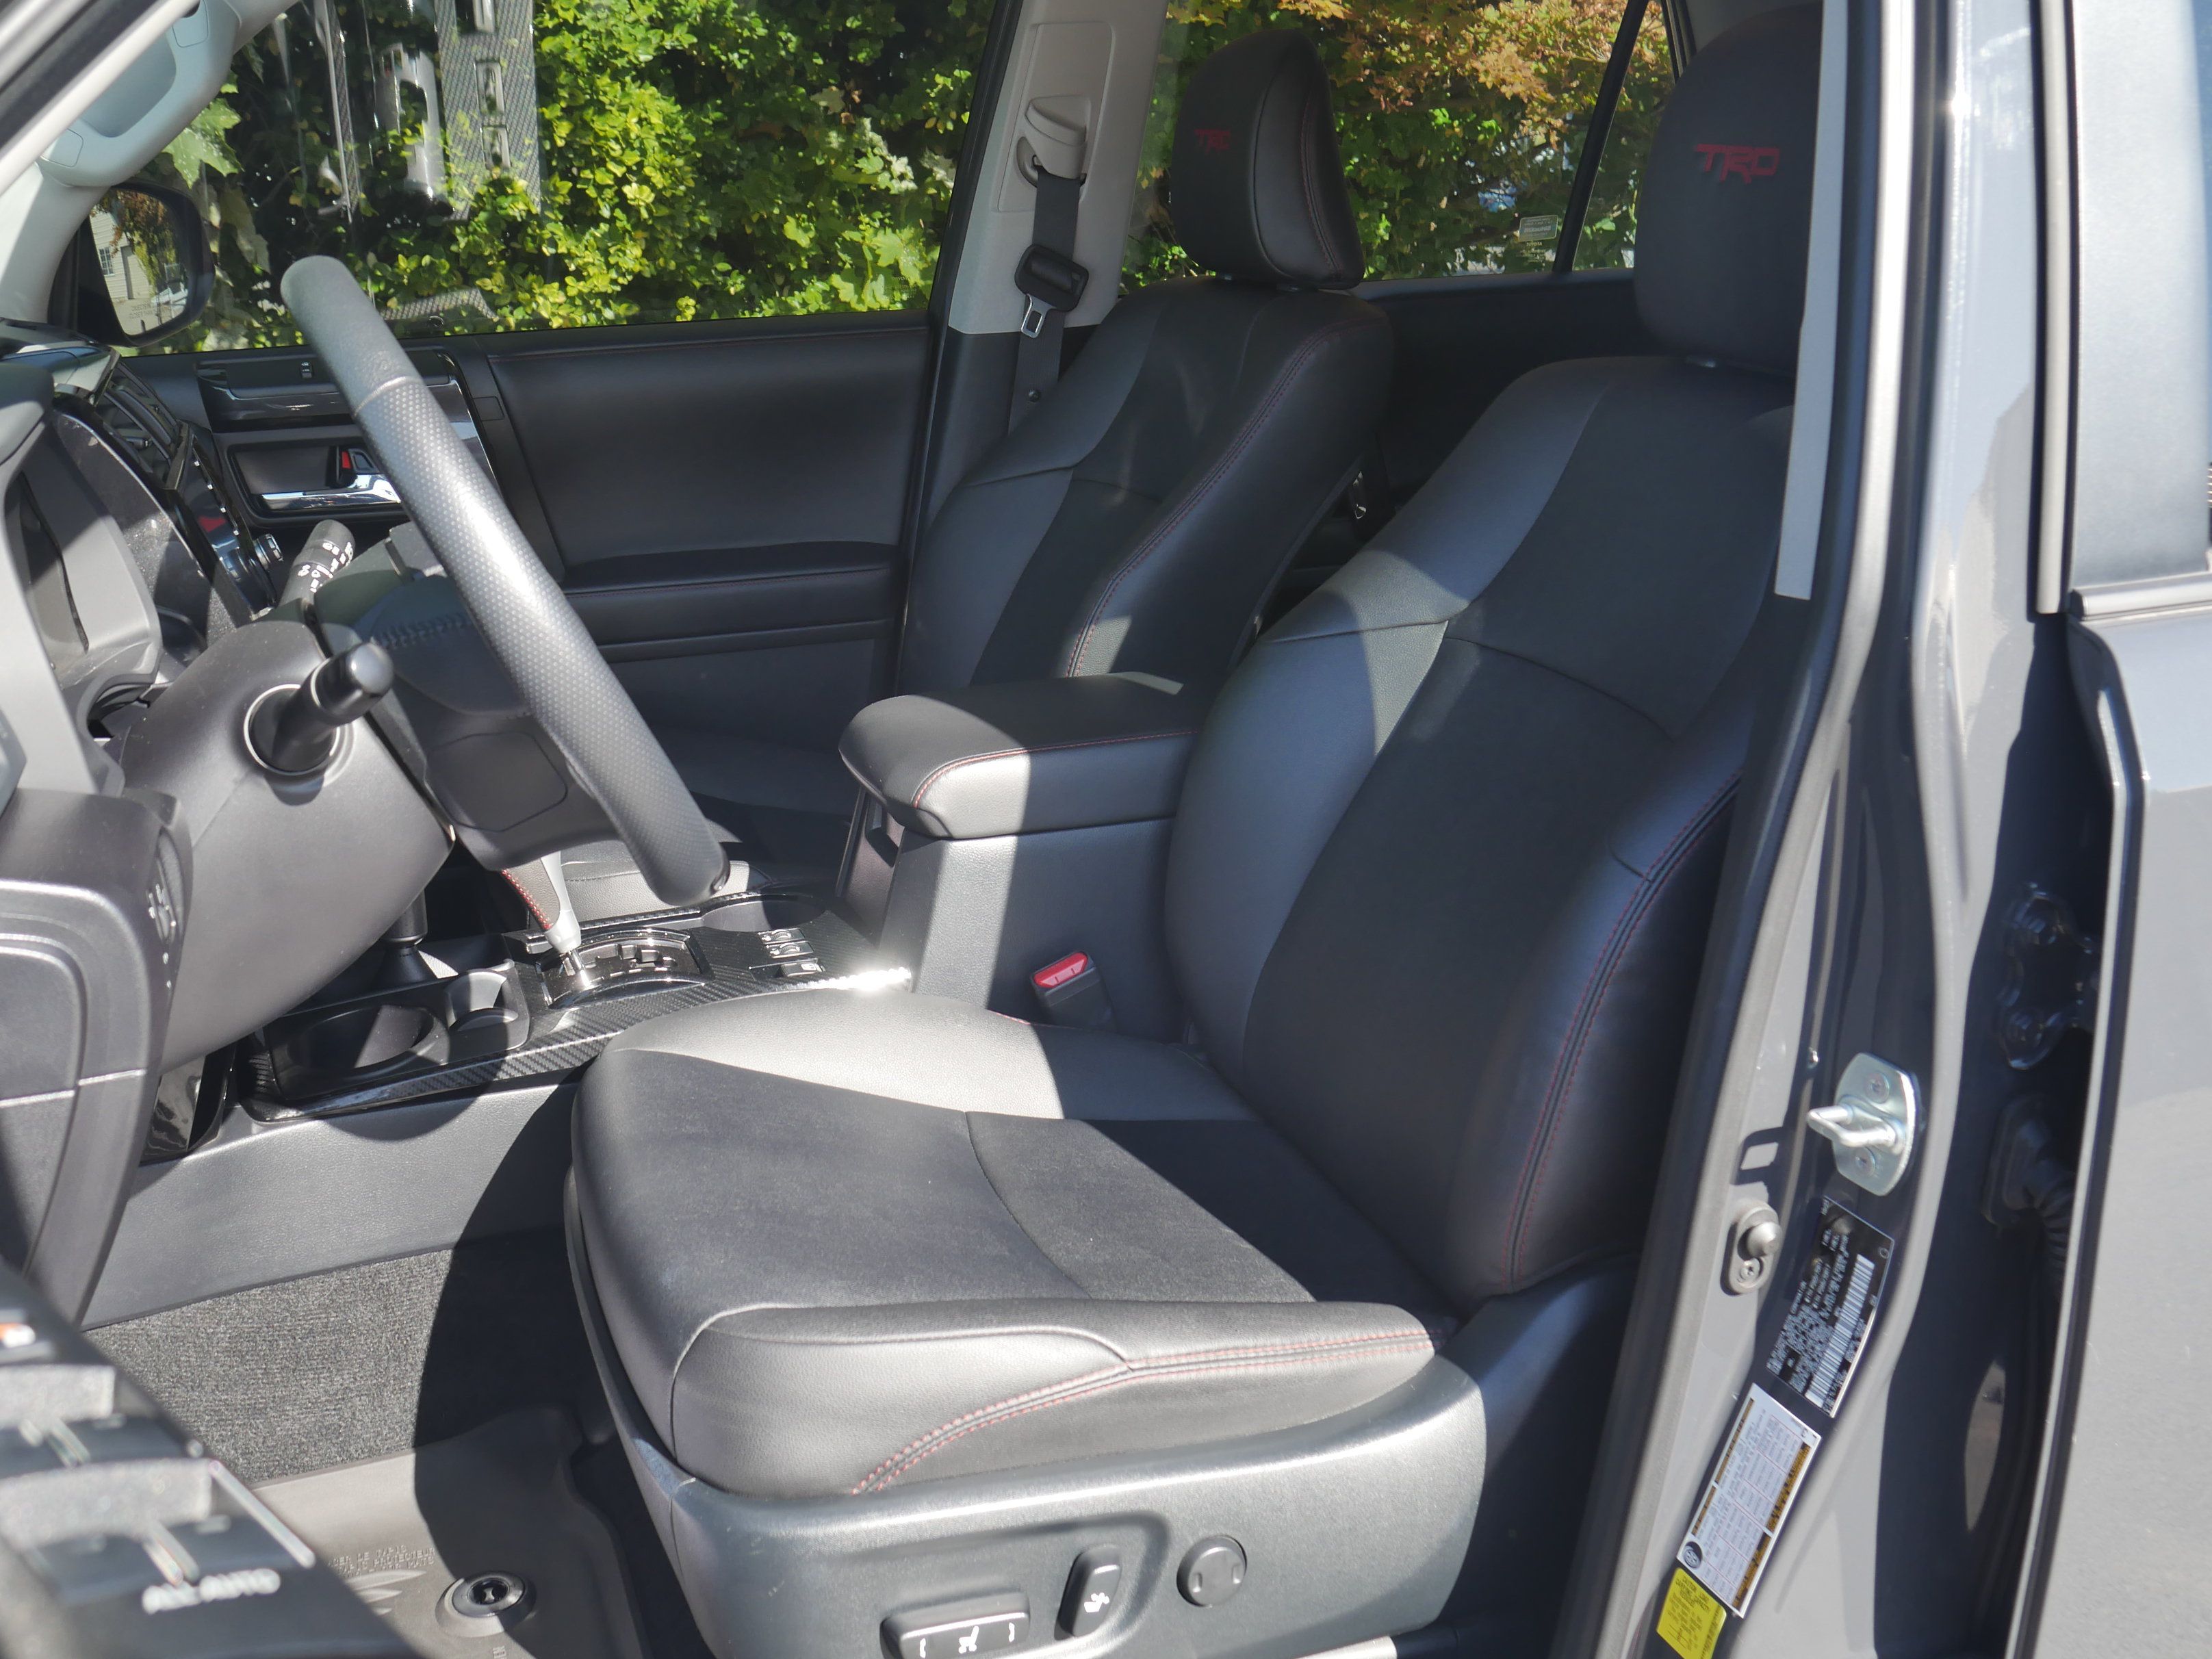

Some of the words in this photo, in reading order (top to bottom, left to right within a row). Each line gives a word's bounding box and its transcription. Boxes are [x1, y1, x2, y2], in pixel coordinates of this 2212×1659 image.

[1194, 128, 1231, 155] TRD
[1694, 143, 1780, 184] TRD
[373, 1546, 435, 1567] PROTECTEUR
[376, 1544, 407, 1558] TAPIS
[407, 1556, 434, 1569] MATS
